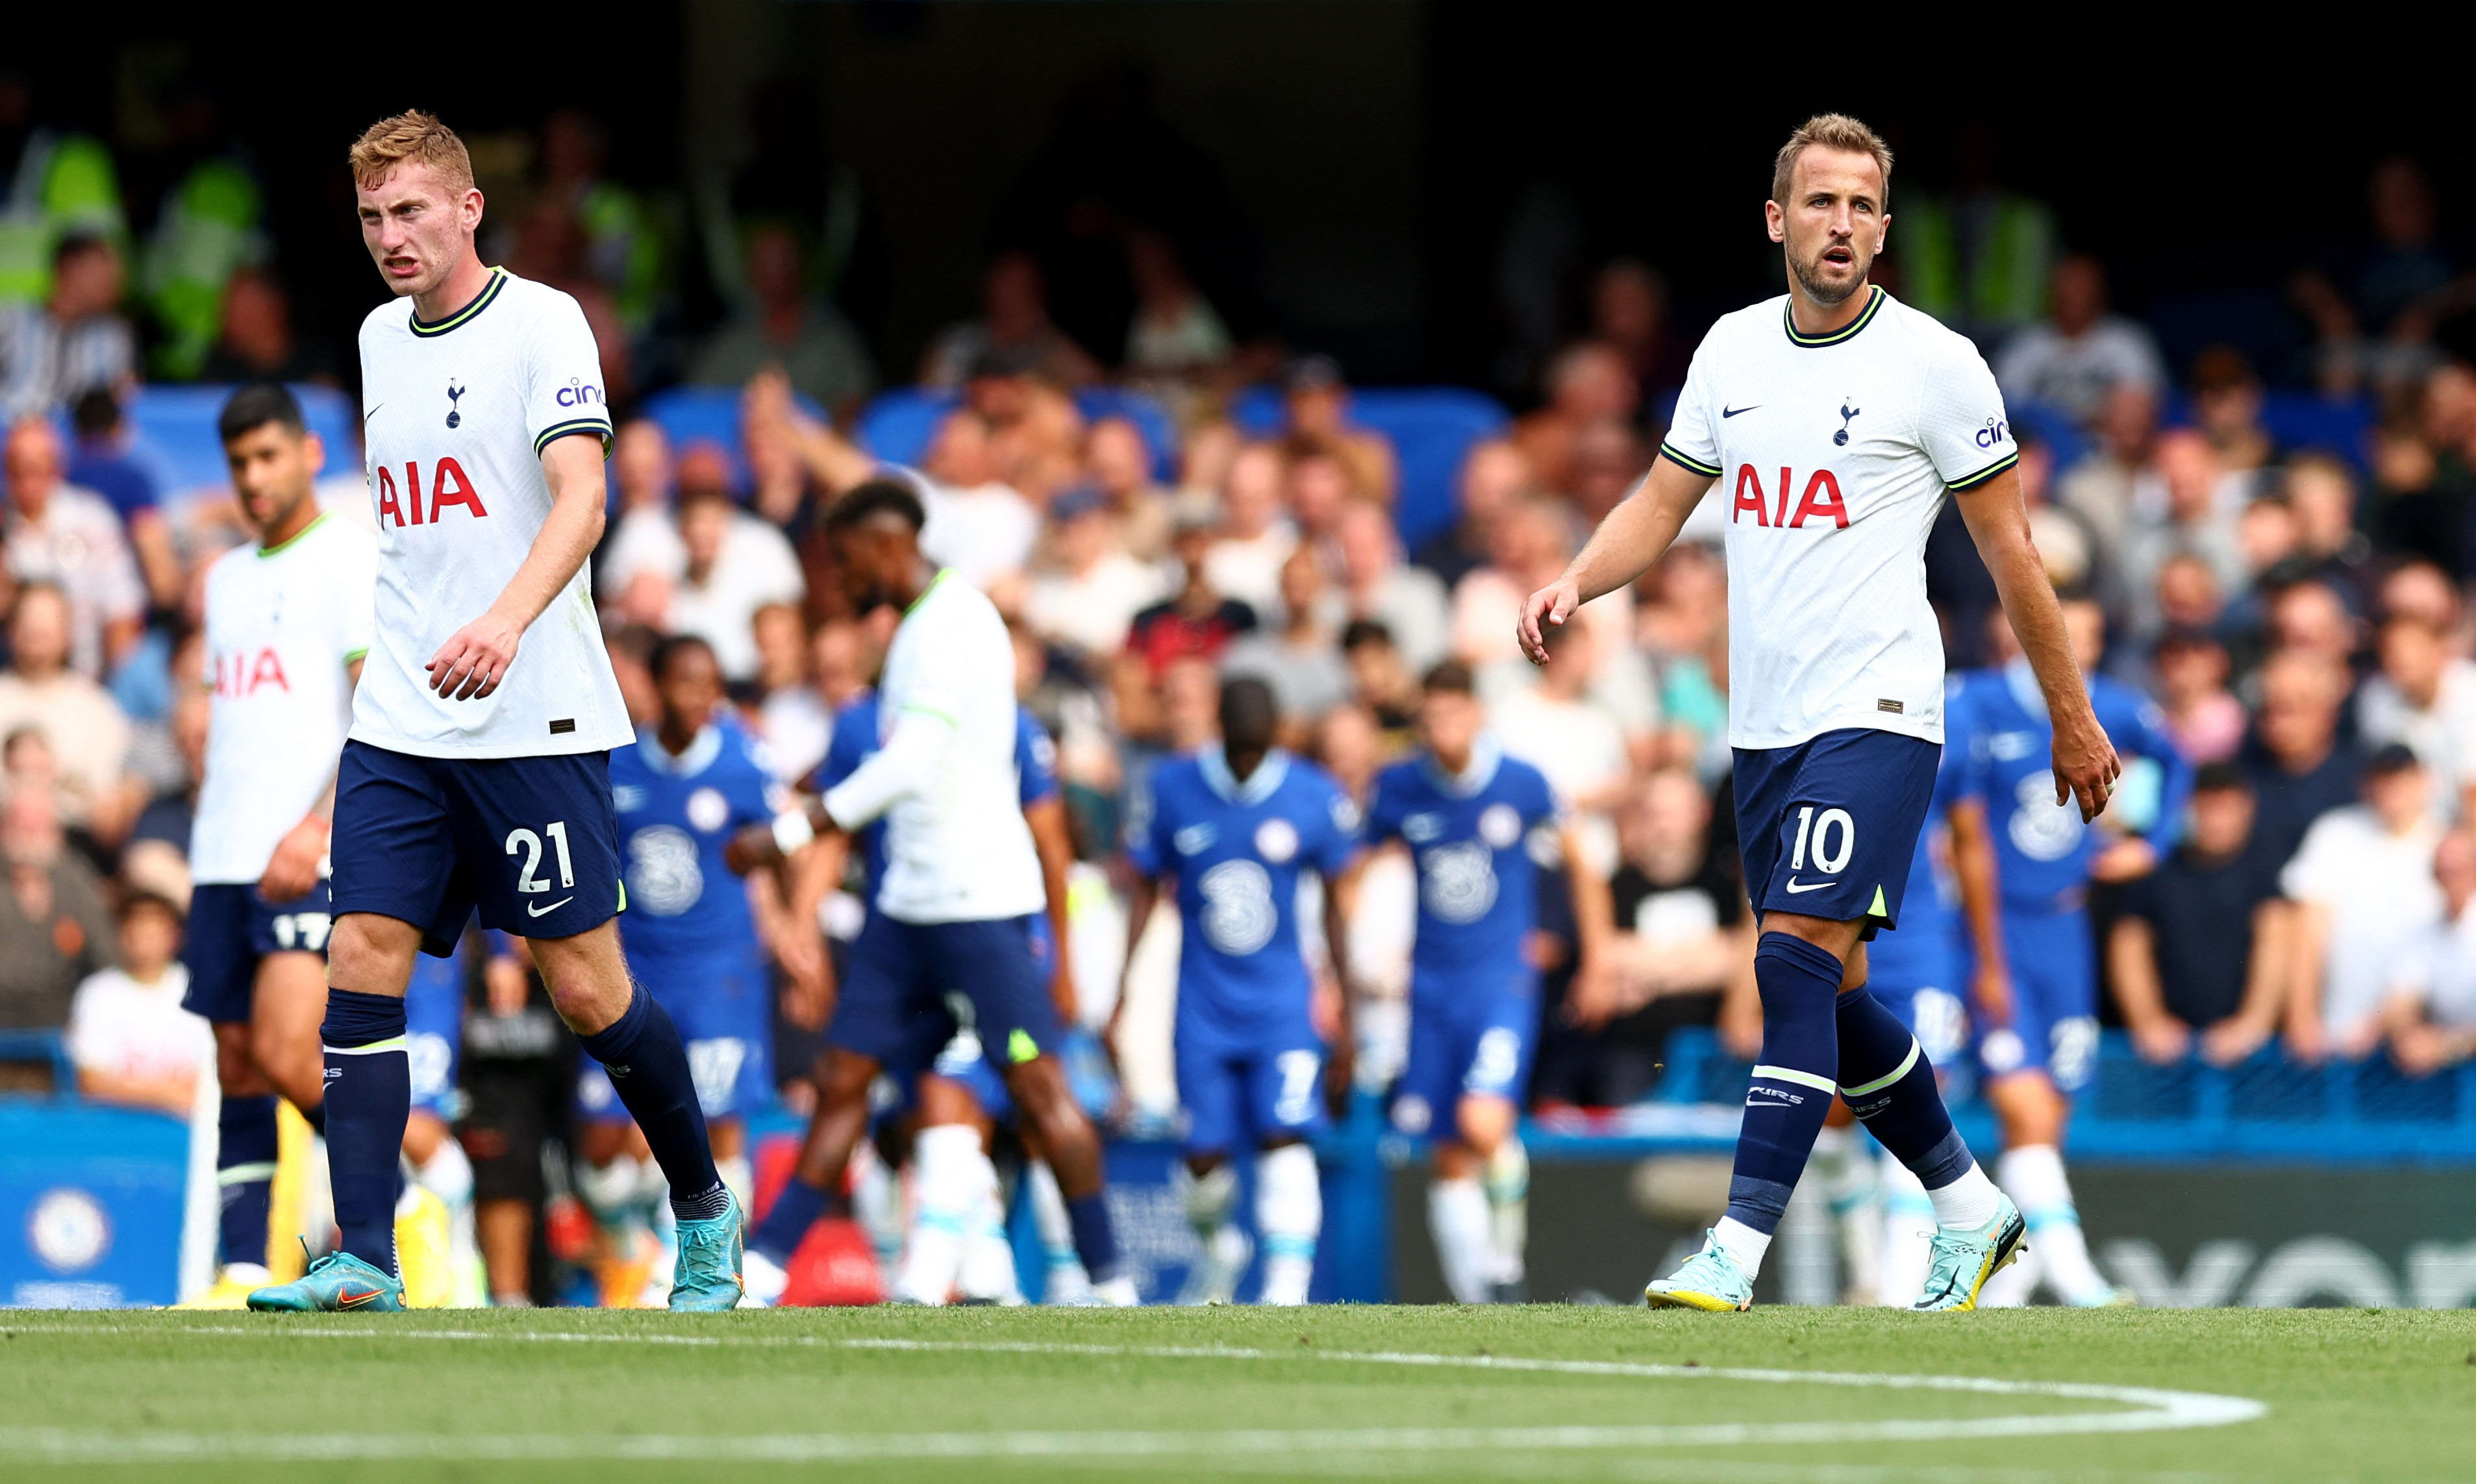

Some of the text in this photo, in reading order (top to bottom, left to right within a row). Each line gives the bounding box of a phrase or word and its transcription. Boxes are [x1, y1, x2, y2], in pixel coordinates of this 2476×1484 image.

[1976, 417, 2010, 448] cin
[378, 457, 488, 531] AIA
[1733, 464, 1850, 529] AIA
[505, 821, 575, 893] 21
[1791, 807, 1855, 874] 10
[272, 912, 332, 950] 17
